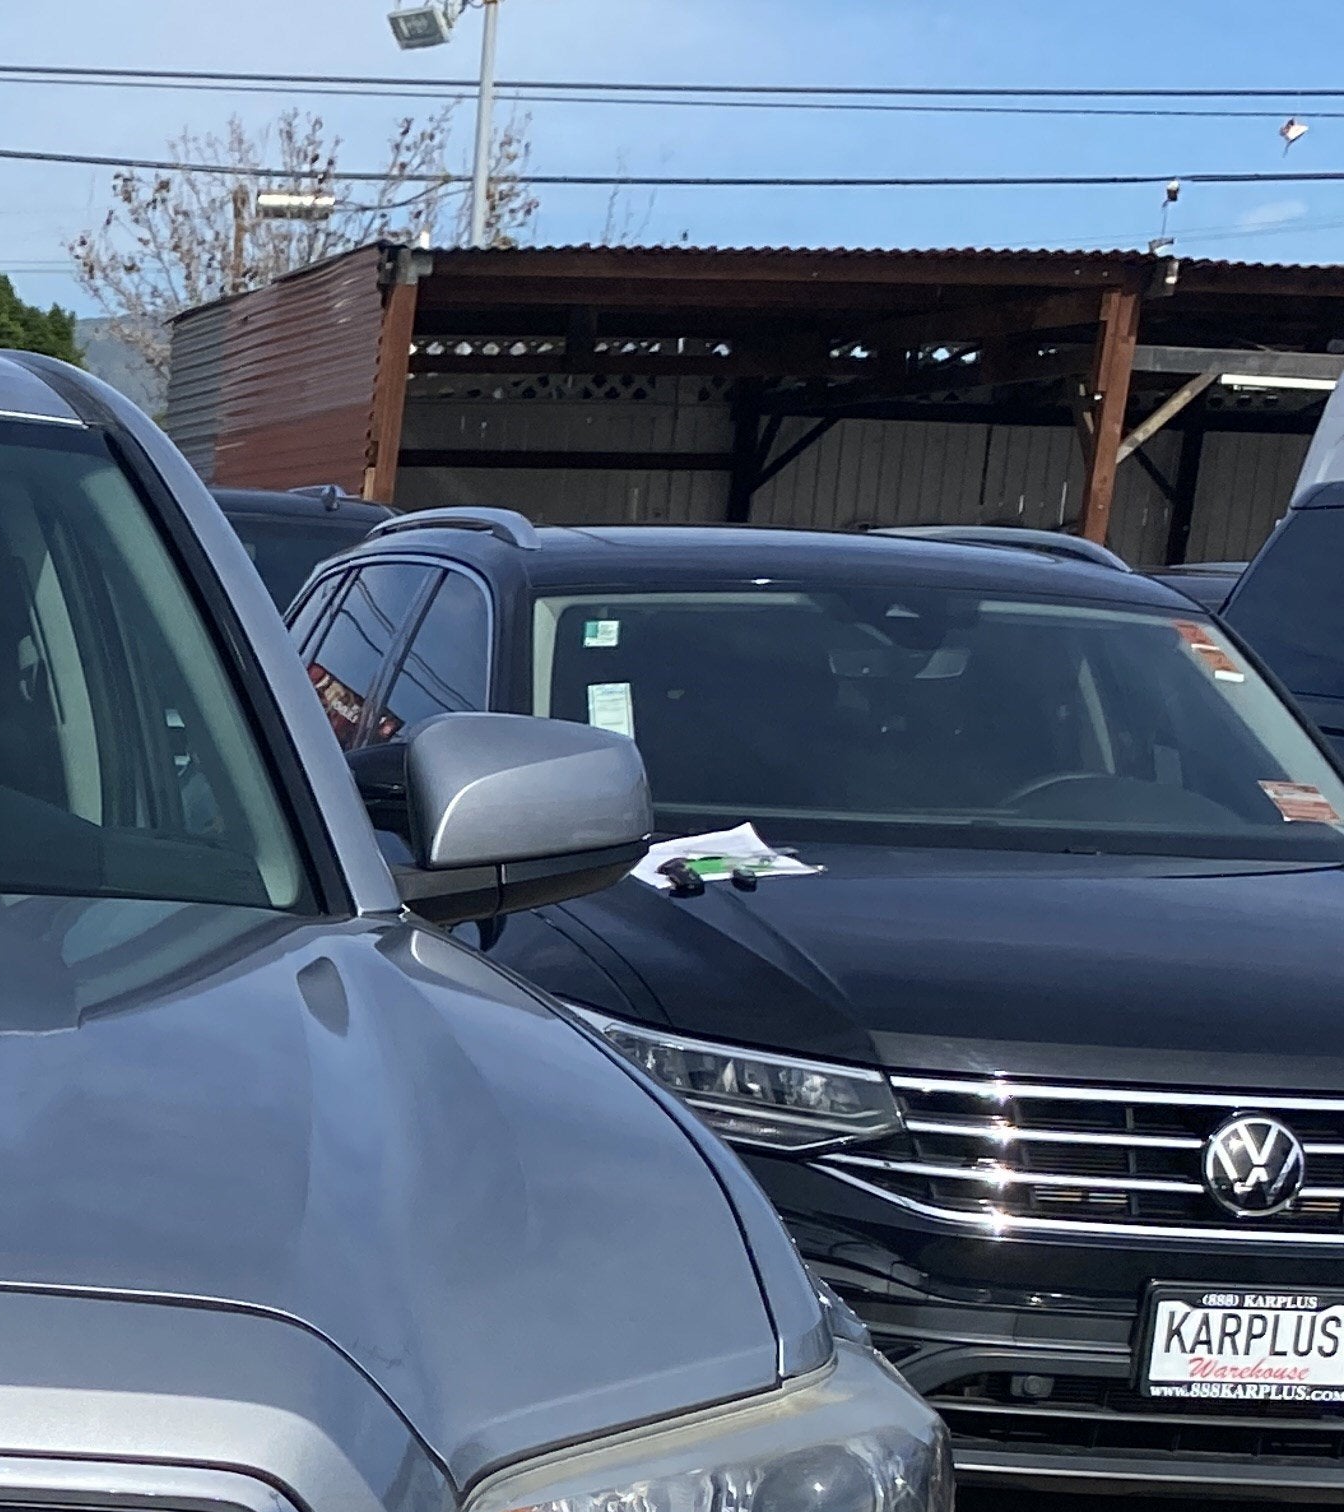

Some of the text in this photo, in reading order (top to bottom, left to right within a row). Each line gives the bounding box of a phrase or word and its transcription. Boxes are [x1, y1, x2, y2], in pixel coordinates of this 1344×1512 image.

[1202, 1294, 1318, 1309] (888) KARPLUS
[1164, 1310, 1343, 1358] KARPLUS
[1188, 1357, 1310, 1381] Warehouse
